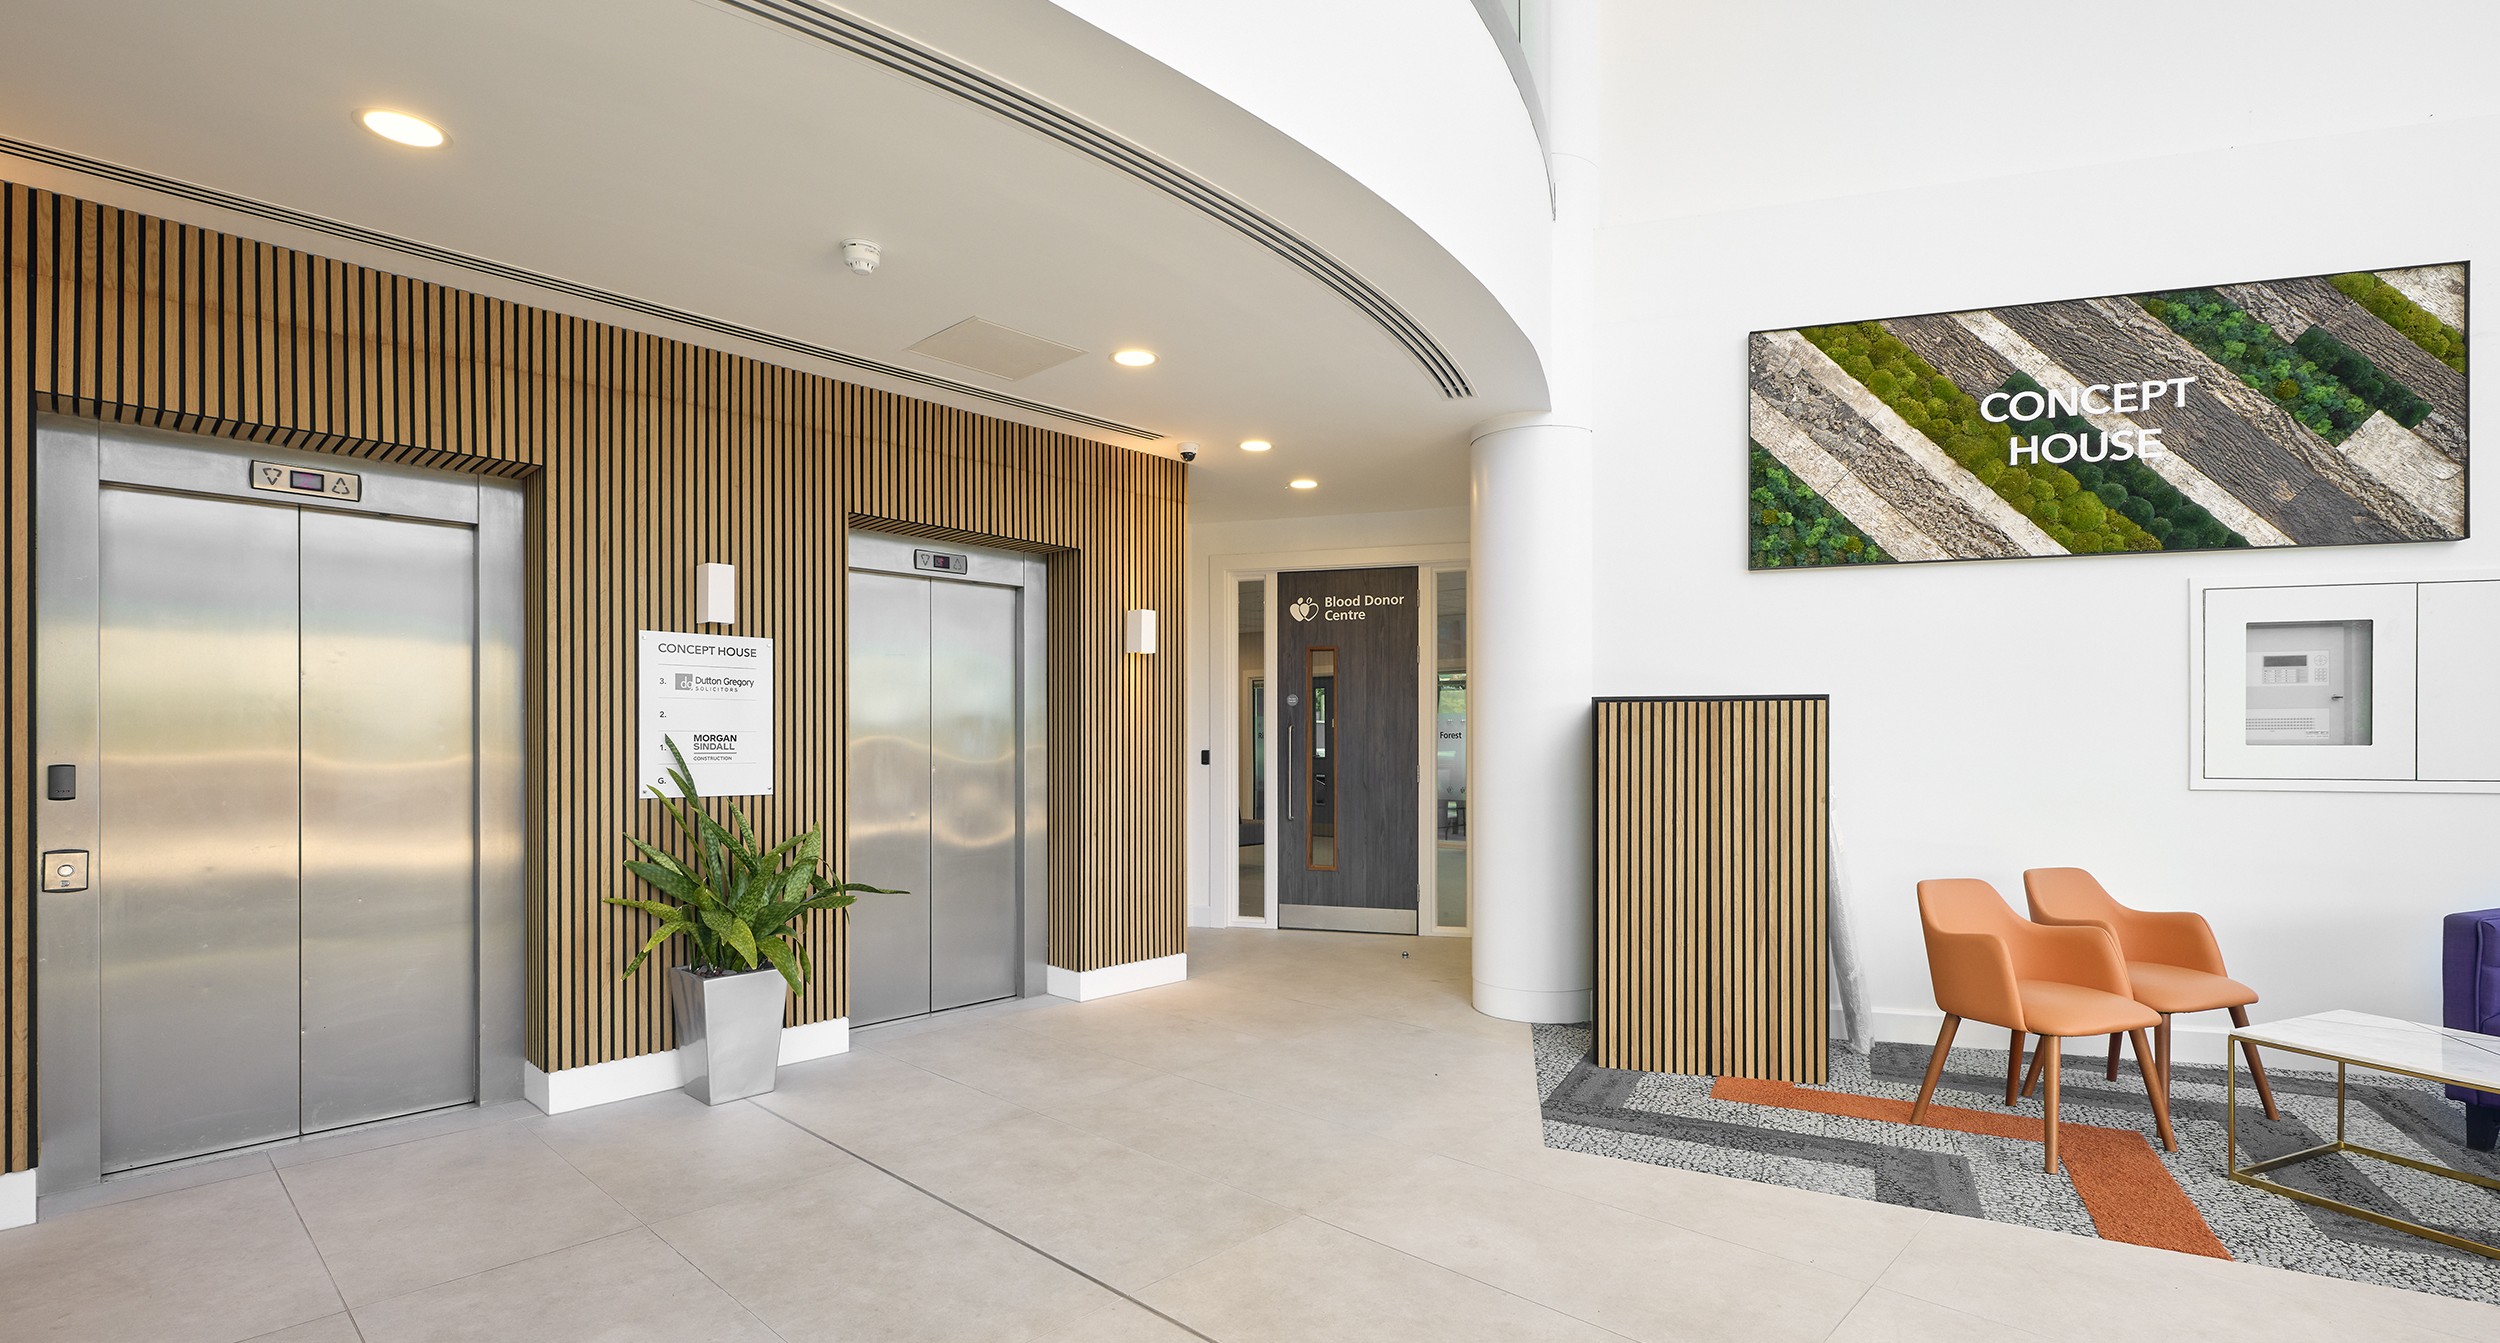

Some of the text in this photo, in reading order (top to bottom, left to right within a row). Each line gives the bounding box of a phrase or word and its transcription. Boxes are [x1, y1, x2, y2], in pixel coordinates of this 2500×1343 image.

[1980, 376, 2196, 423] CONCEPT
[2010, 428, 2162, 466] HOUSE
[1324, 594, 1405, 608] Blood Donor
[1324, 609, 1366, 622] Centre
[658, 643, 757, 658] CONCEPT HOUSE
[659, 677, 667, 685] 3.
[695, 676, 722, 687] Dutton
[723, 677, 755, 689] Gregory
[659, 710, 667, 718] 2.
[693, 734, 737, 743] MORGAN
[1439, 731, 1463, 740] Forest
[693, 742, 735, 751] SINDALL
[657, 777, 666, 785] G.
